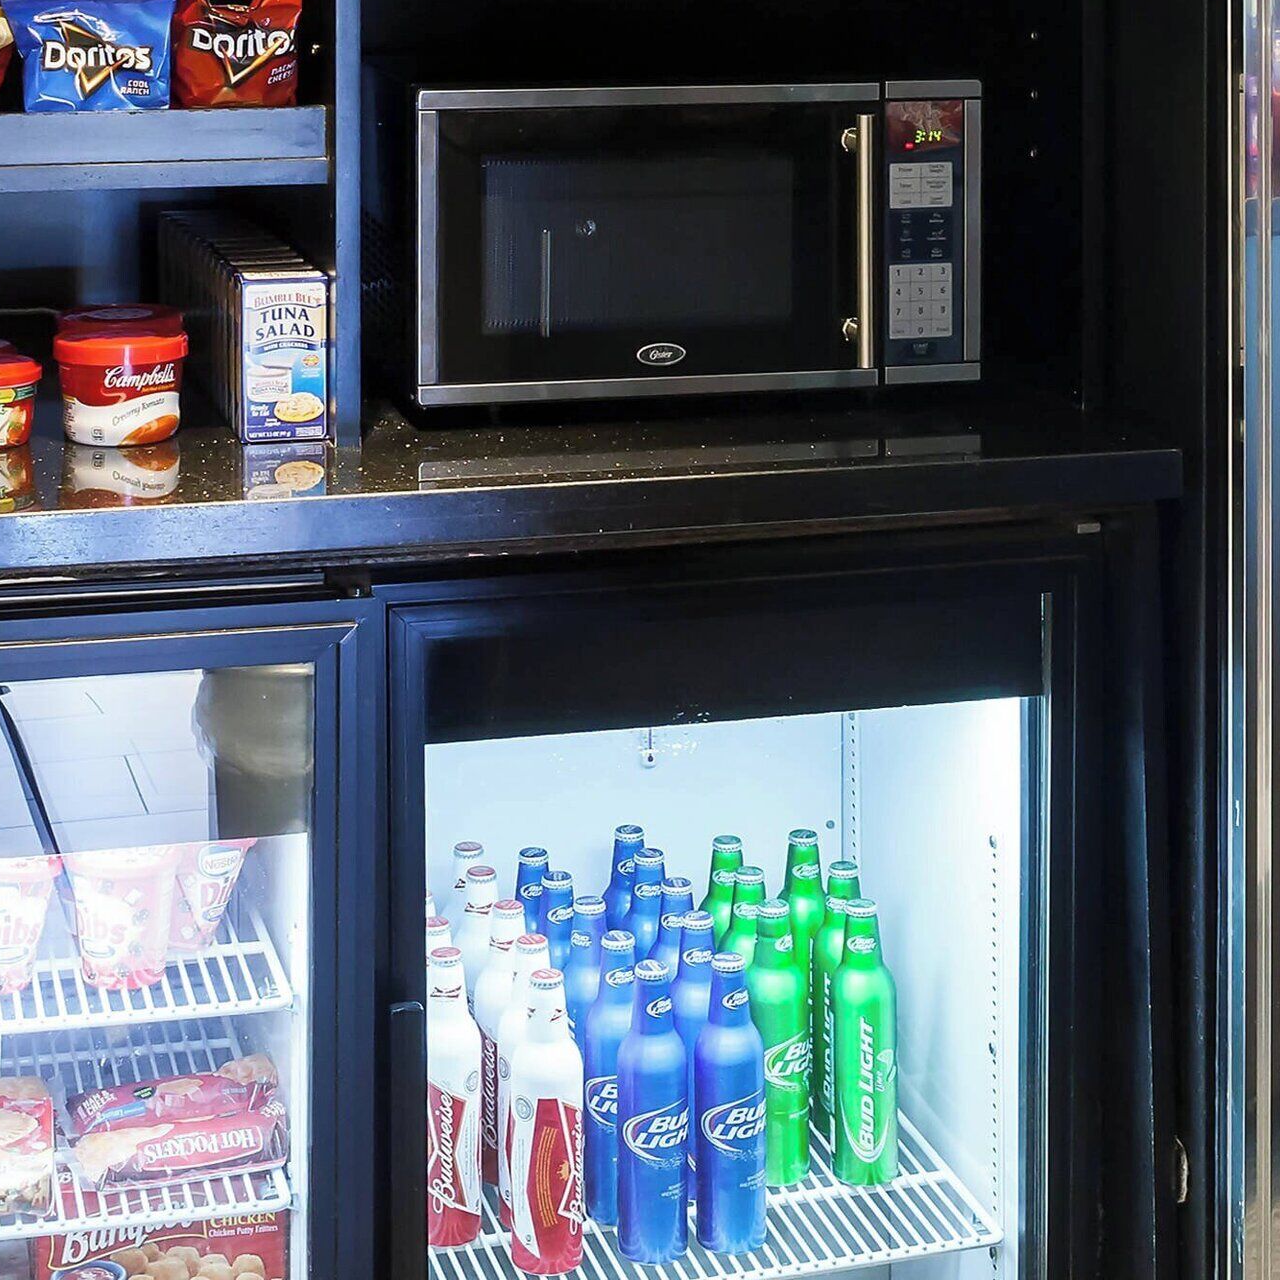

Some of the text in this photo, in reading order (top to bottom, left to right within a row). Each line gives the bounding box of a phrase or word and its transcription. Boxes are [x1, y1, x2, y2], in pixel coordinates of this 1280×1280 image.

[44, 41, 152, 70] Doritos
[120, 86, 150, 96] RANCH
[127, 79, 149, 89] COOL
[914, 130, 942, 144] 3:14
[254, 293, 293, 308] BUMBLE
[260, 306, 310, 324] TUNA
[255, 323, 315, 342] SALAD
[279, 342, 309, 350] CRACKERS
[104, 363, 176, 391] Campbell's
[112, 397, 166, 426] Creamy Tomato
[785, 1039, 810, 1061] BU
[481, 1039, 497, 1150] Budweise
[859, 1015, 874, 1151] BUD LIGHT
[633, 1123, 689, 1149] LIGH
[711, 1115, 766, 1140] LIGH
[144, 1127, 257, 1164] HOT POCKETS
[428, 1088, 454, 1214] Budweise
[568, 1106, 585, 1236] Budweise
[208, 1227, 236, 1237] Chicken
[209, 1212, 277, 1229] CHICKEN
